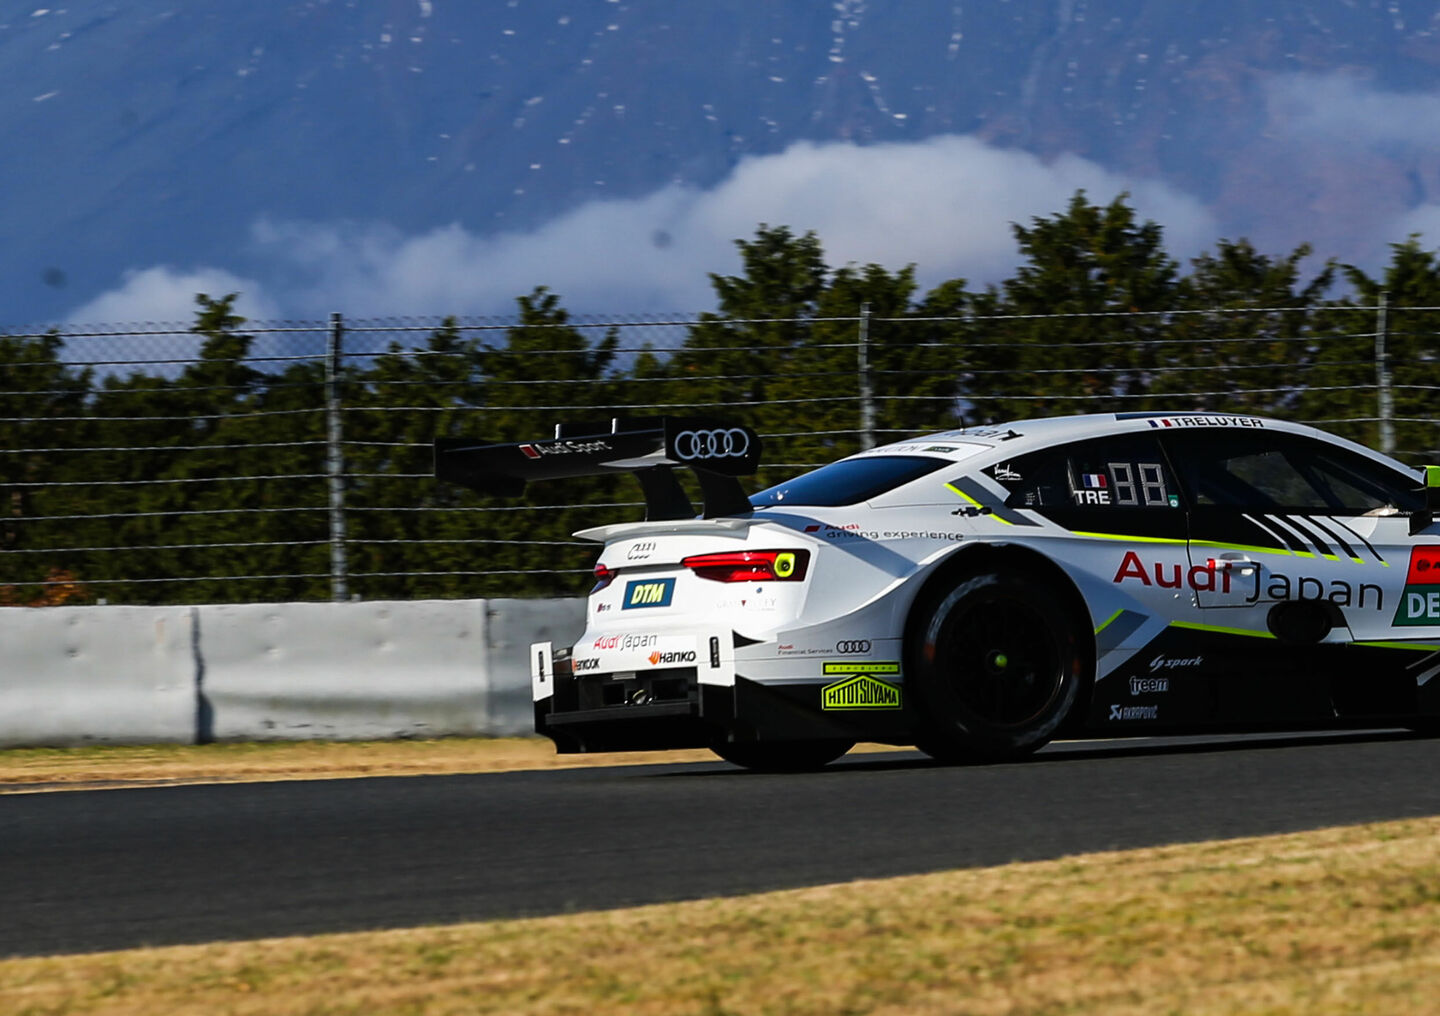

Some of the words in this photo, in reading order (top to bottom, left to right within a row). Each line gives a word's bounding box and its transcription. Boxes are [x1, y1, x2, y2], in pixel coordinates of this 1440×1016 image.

[1171, 417, 1264, 428] TRELUYER
[1073, 490, 1110, 505] TRE
[826, 530, 879, 539] driving
[883, 530, 965, 541] experience
[1113, 551, 1231, 594] Audi
[1246, 561, 1384, 611] Japan
[631, 583, 665, 605] DTM
[593, 635, 621, 650] Audi
[620, 633, 658, 651] Japan
[1164, 656, 1203, 669] spark
[828, 678, 897, 705] HITOTSUYAMA
